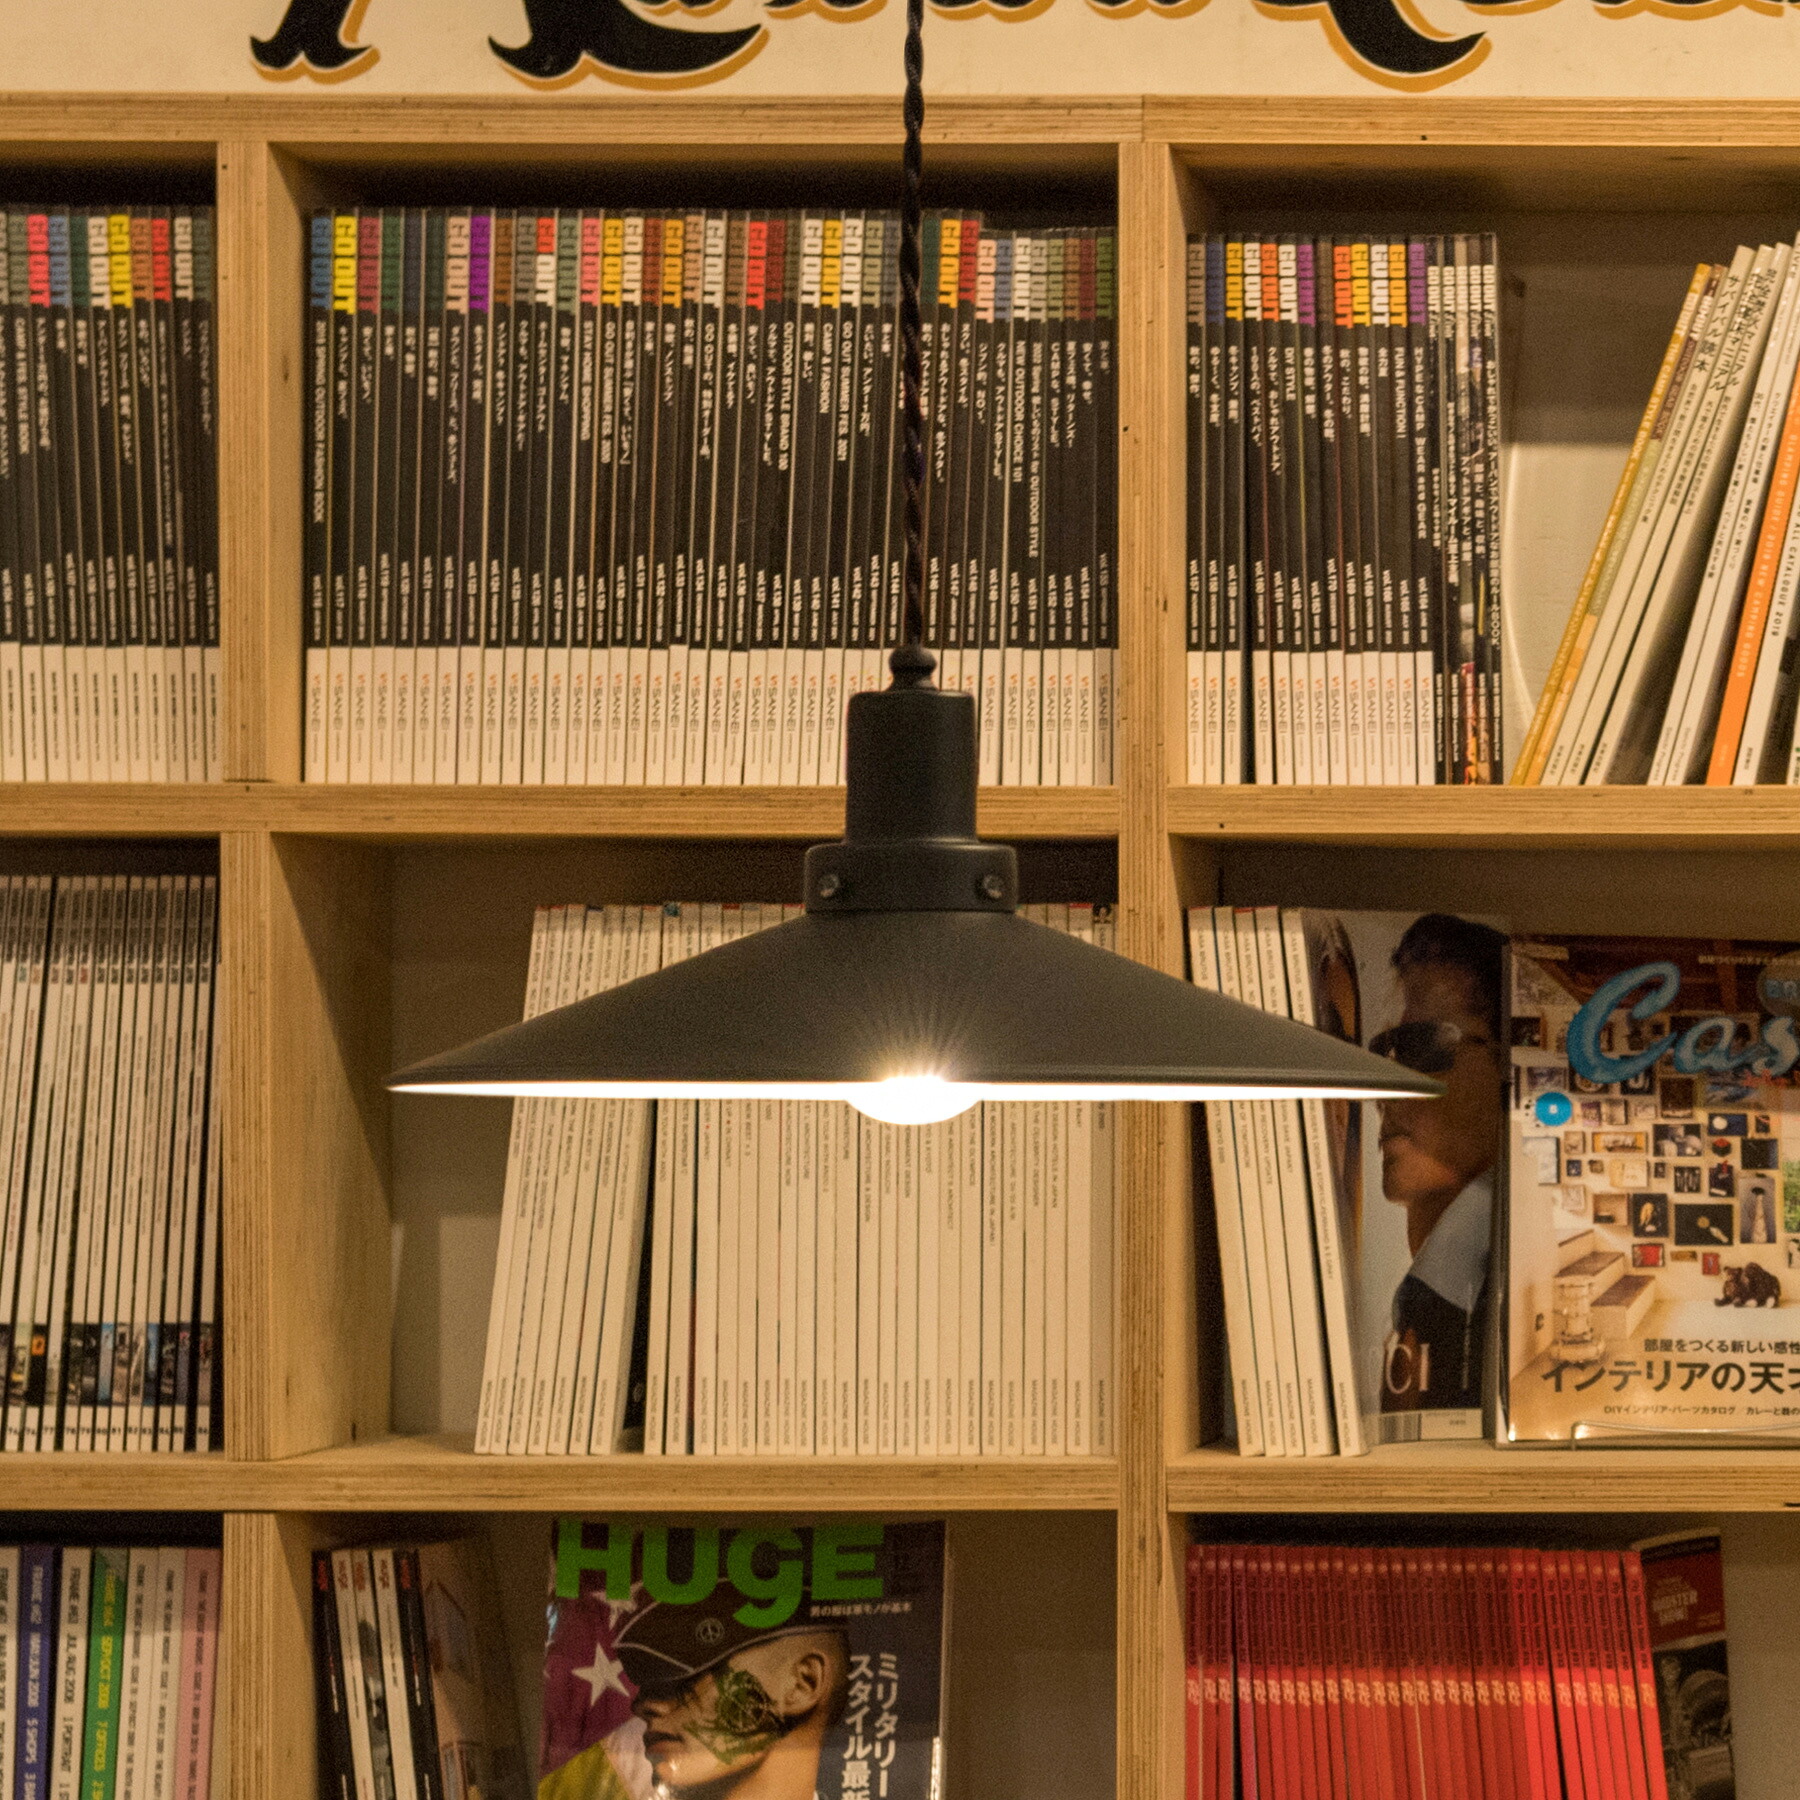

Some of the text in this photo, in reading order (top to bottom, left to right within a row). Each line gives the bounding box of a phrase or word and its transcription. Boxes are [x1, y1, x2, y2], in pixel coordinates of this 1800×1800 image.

[88, 216, 111, 310] GO OUT
[108, 215, 132, 309] GO OUT
[333, 216, 356, 314] GO OUT
[447, 217, 468, 314] GO OUT
[535, 218, 555, 306] GO OUT
[602, 219, 623, 308] GO OUT
[622, 217, 643, 306] GO OUT
[662, 220, 683, 308] GO OUT
[703, 220, 724, 308] GO OUT
[746, 222, 767, 310] GO OUT
[801, 220, 823, 308] GO OUT
[821, 219, 843, 309] GO OUT
[841, 219, 862, 308] GO OUT
[938, 220, 960, 308] GO OUT
[975, 239, 996, 324] GO OUT
[995, 239, 1013, 322] GO OUT
[1013, 238, 1031, 322] GO OUT
[1030, 240, 1047, 323] GO OUT
[1048, 239, 1064, 322] GO OUT
[1226, 243, 1243, 321] GO OUT
[1244, 243, 1262, 321] GO OUT
[1261, 244, 1279, 322] GO OUT
[1279, 245, 1298, 323] GO OUT
[1334, 246, 1353, 328] GO OUT
[1352, 244, 1370, 327] GO OUT
[1371, 244, 1389, 327] GO OUT
[1389, 244, 1407, 327] GO OUT
[1014, 368, 1025, 422] OUTDOOR
[1015, 341, 1026, 366] NEW
[1394, 347, 1405, 369] FUN
[1013, 424, 1024, 463] CHOICE
[1028, 526, 1039, 557] STYLE
[1029, 476, 1040, 524] OUTDOOR
[554, 1517, 885, 1630] HUGE
[874, 1652, 899, 1798] ミリタリー
